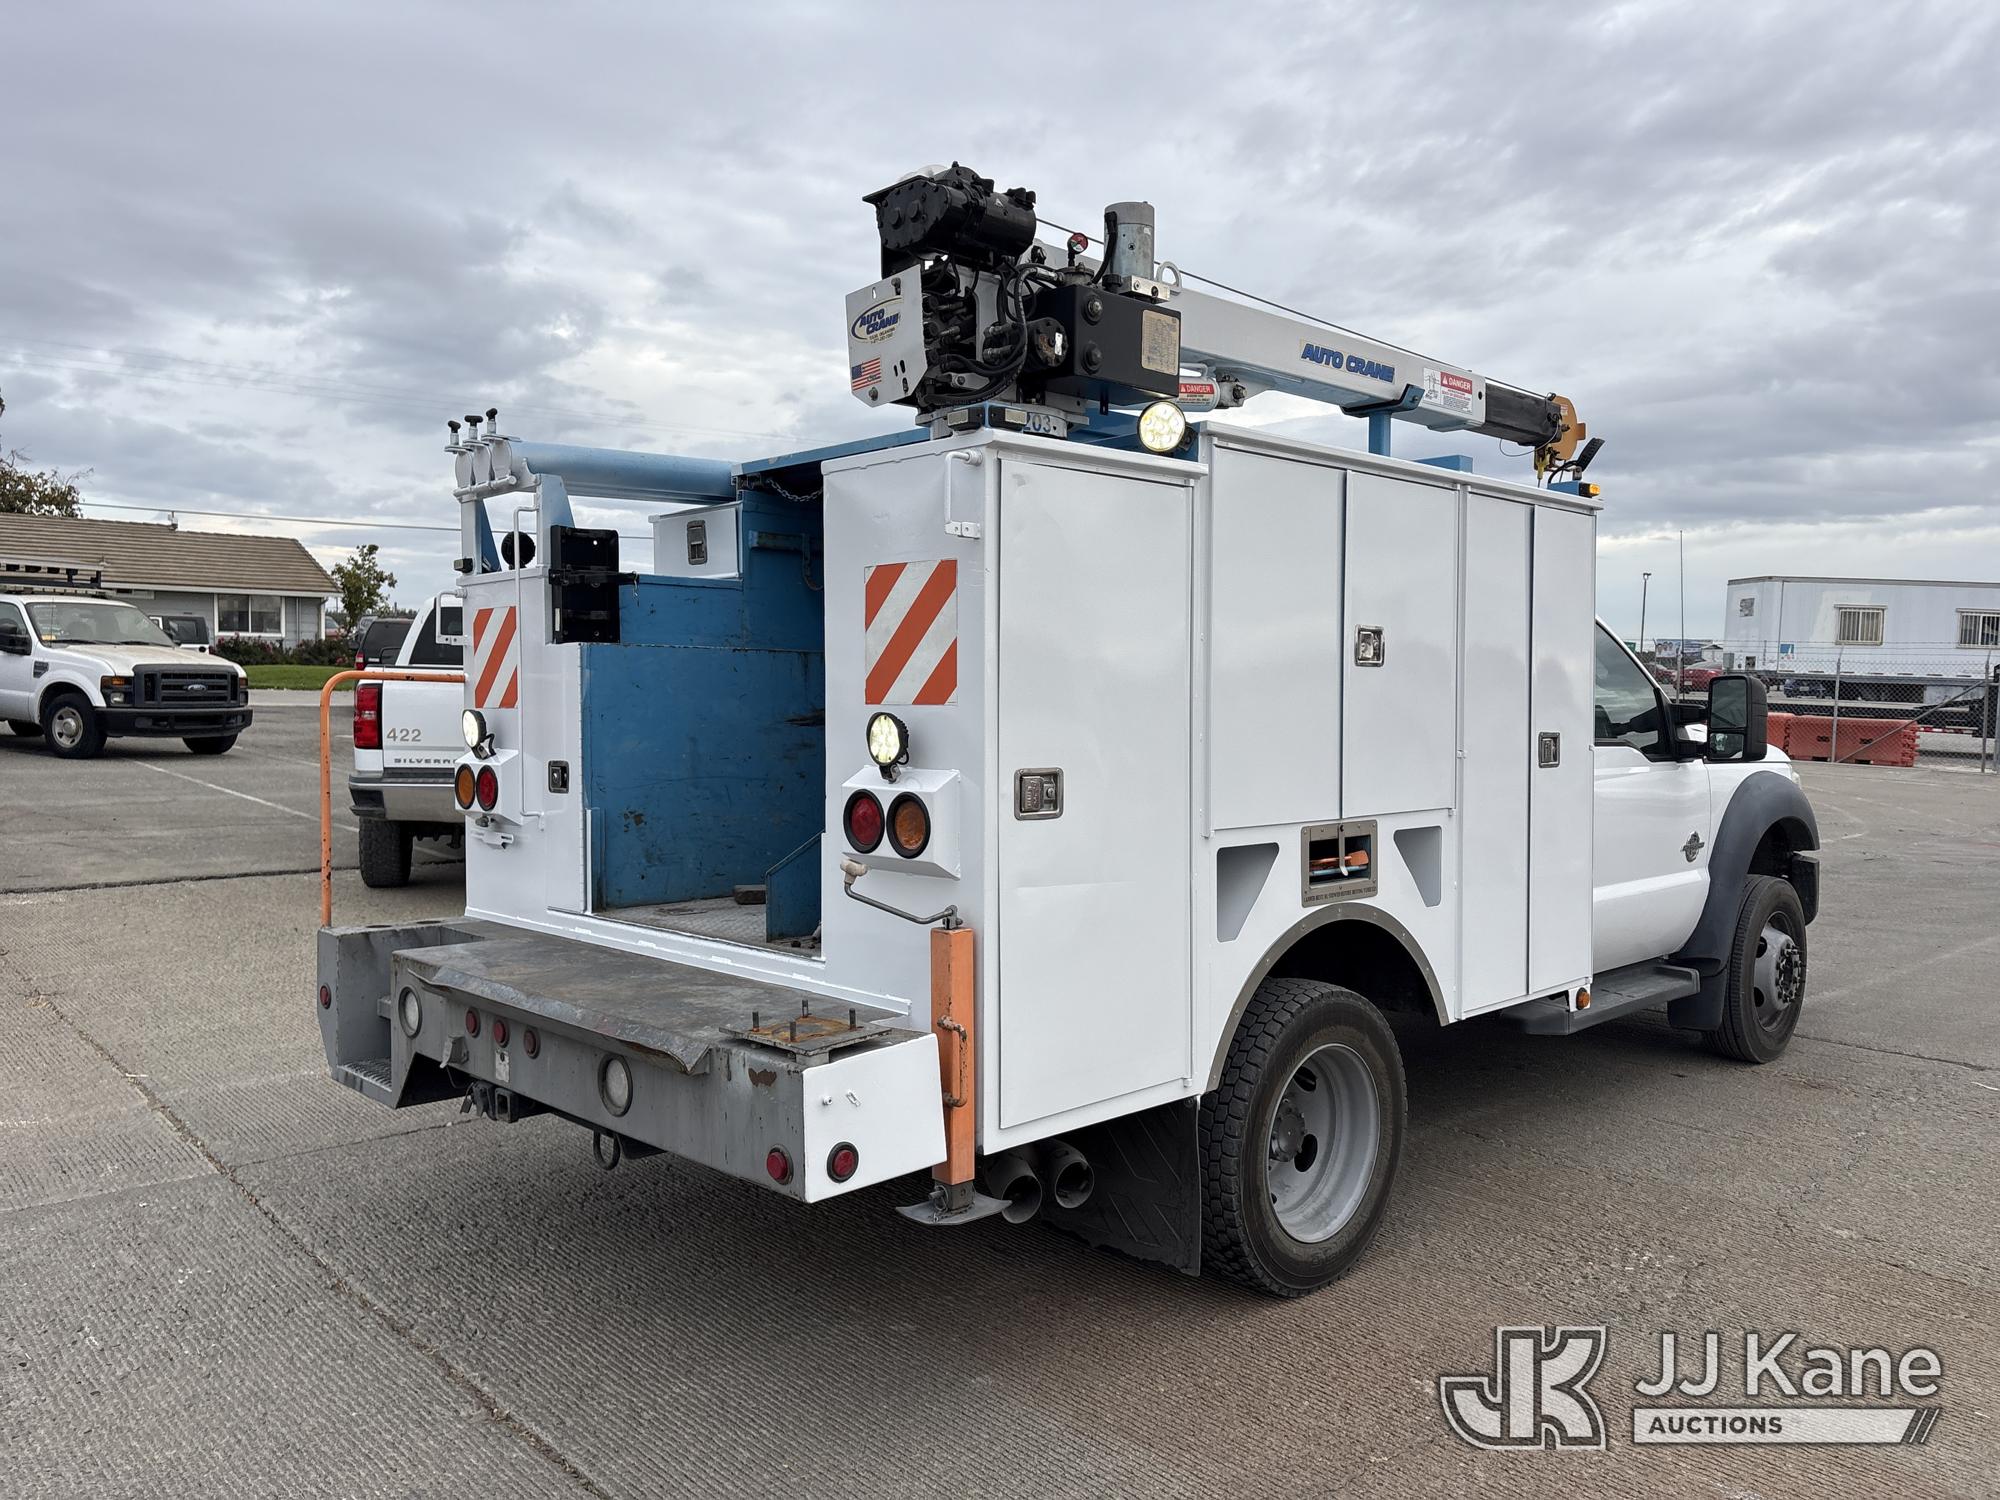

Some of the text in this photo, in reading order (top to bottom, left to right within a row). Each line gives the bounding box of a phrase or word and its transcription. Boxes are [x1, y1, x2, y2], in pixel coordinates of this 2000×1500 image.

[859, 308, 885, 328] AUTO
[866, 312, 899, 336] CRANE
[1301, 343, 1395, 383] AUTO CRANE
[1186, 384, 1211, 393] DANGER
[1448, 377, 1471, 391] DANGER
[386, 728, 422, 742] 422
